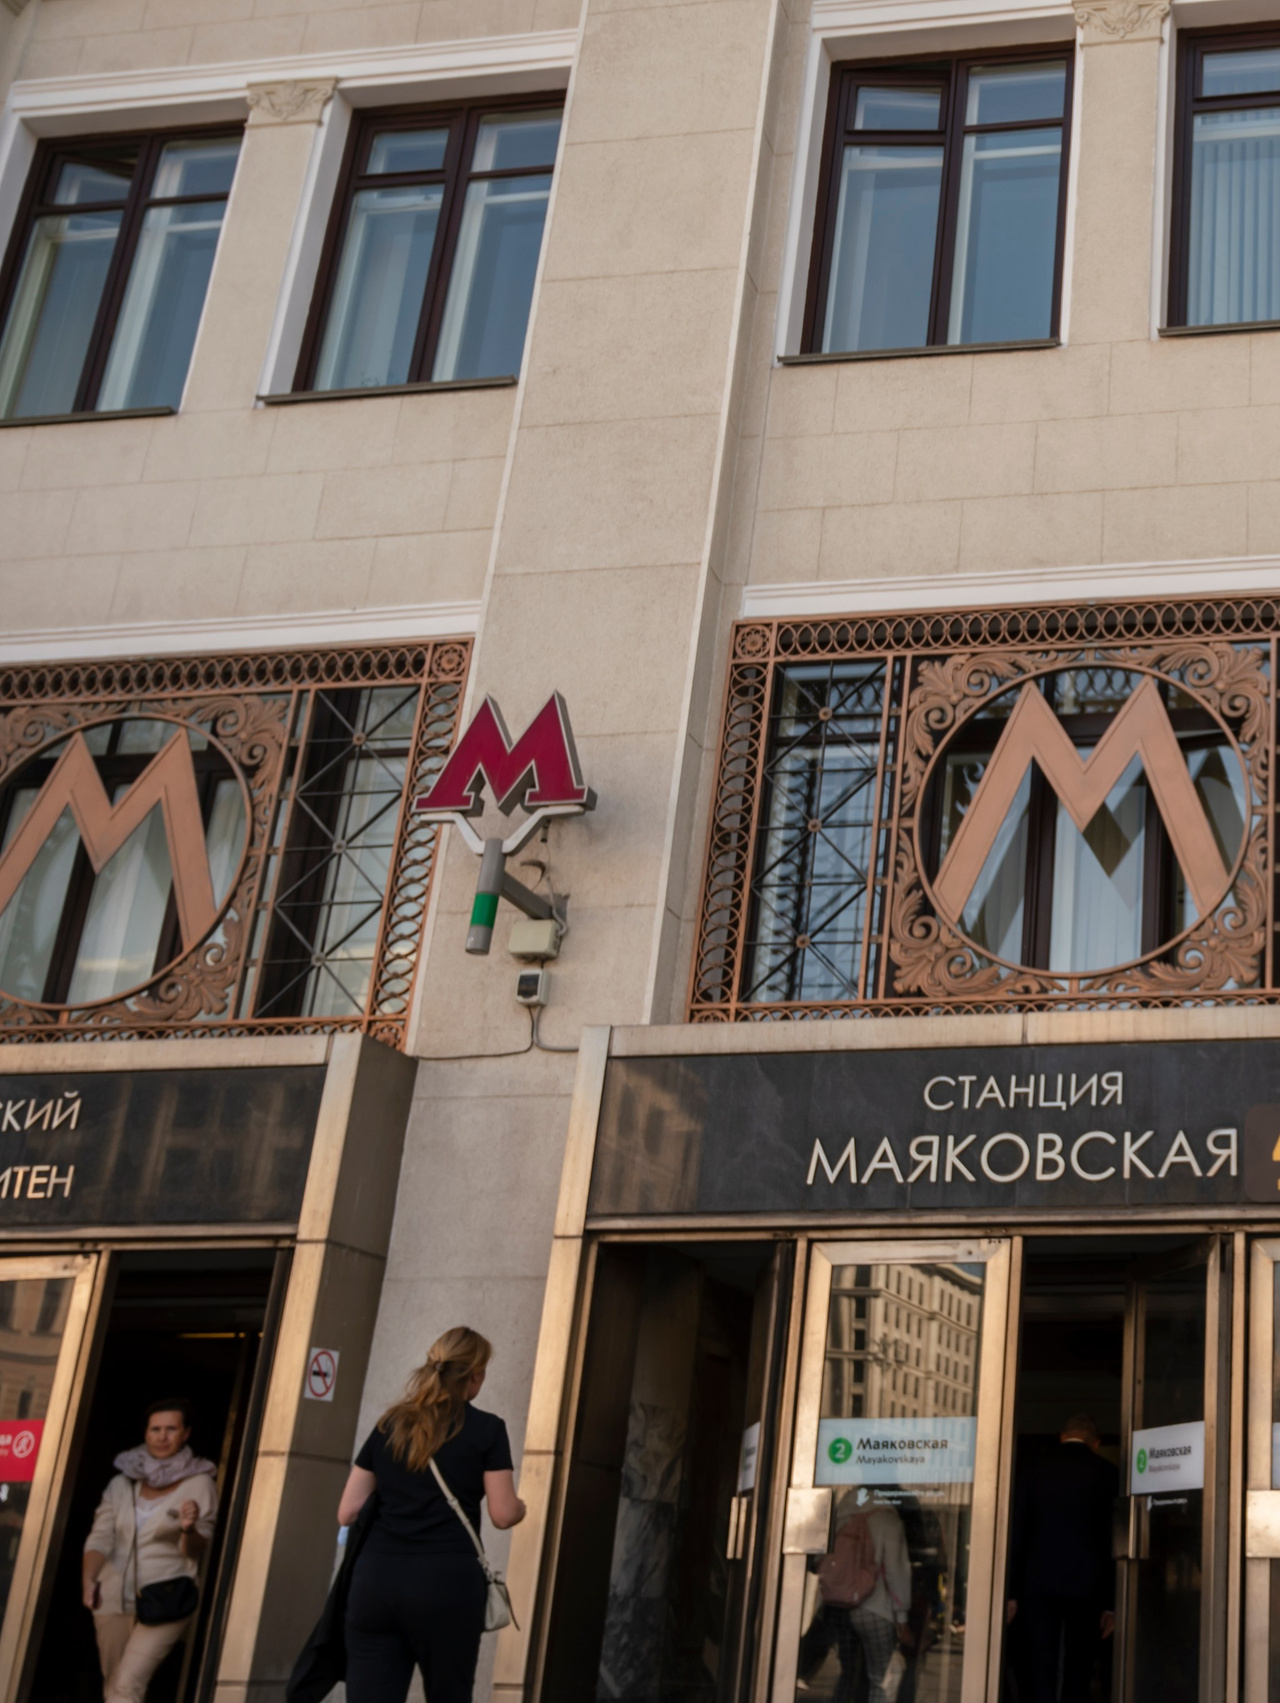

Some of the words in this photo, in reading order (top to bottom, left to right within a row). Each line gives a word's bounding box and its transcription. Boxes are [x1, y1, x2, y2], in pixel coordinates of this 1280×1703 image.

[923, 1071, 1123, 1111] СТАНЦИЯ
[0, 1090, 81, 1132] КИЙ
[806, 1128, 1238, 1186] МАЯКОВСКАЯ
[833, 1442, 846, 1459] 2
[857, 1437, 949, 1451] Маяковская
[856, 1454, 926, 1466] Mayakovskaya
